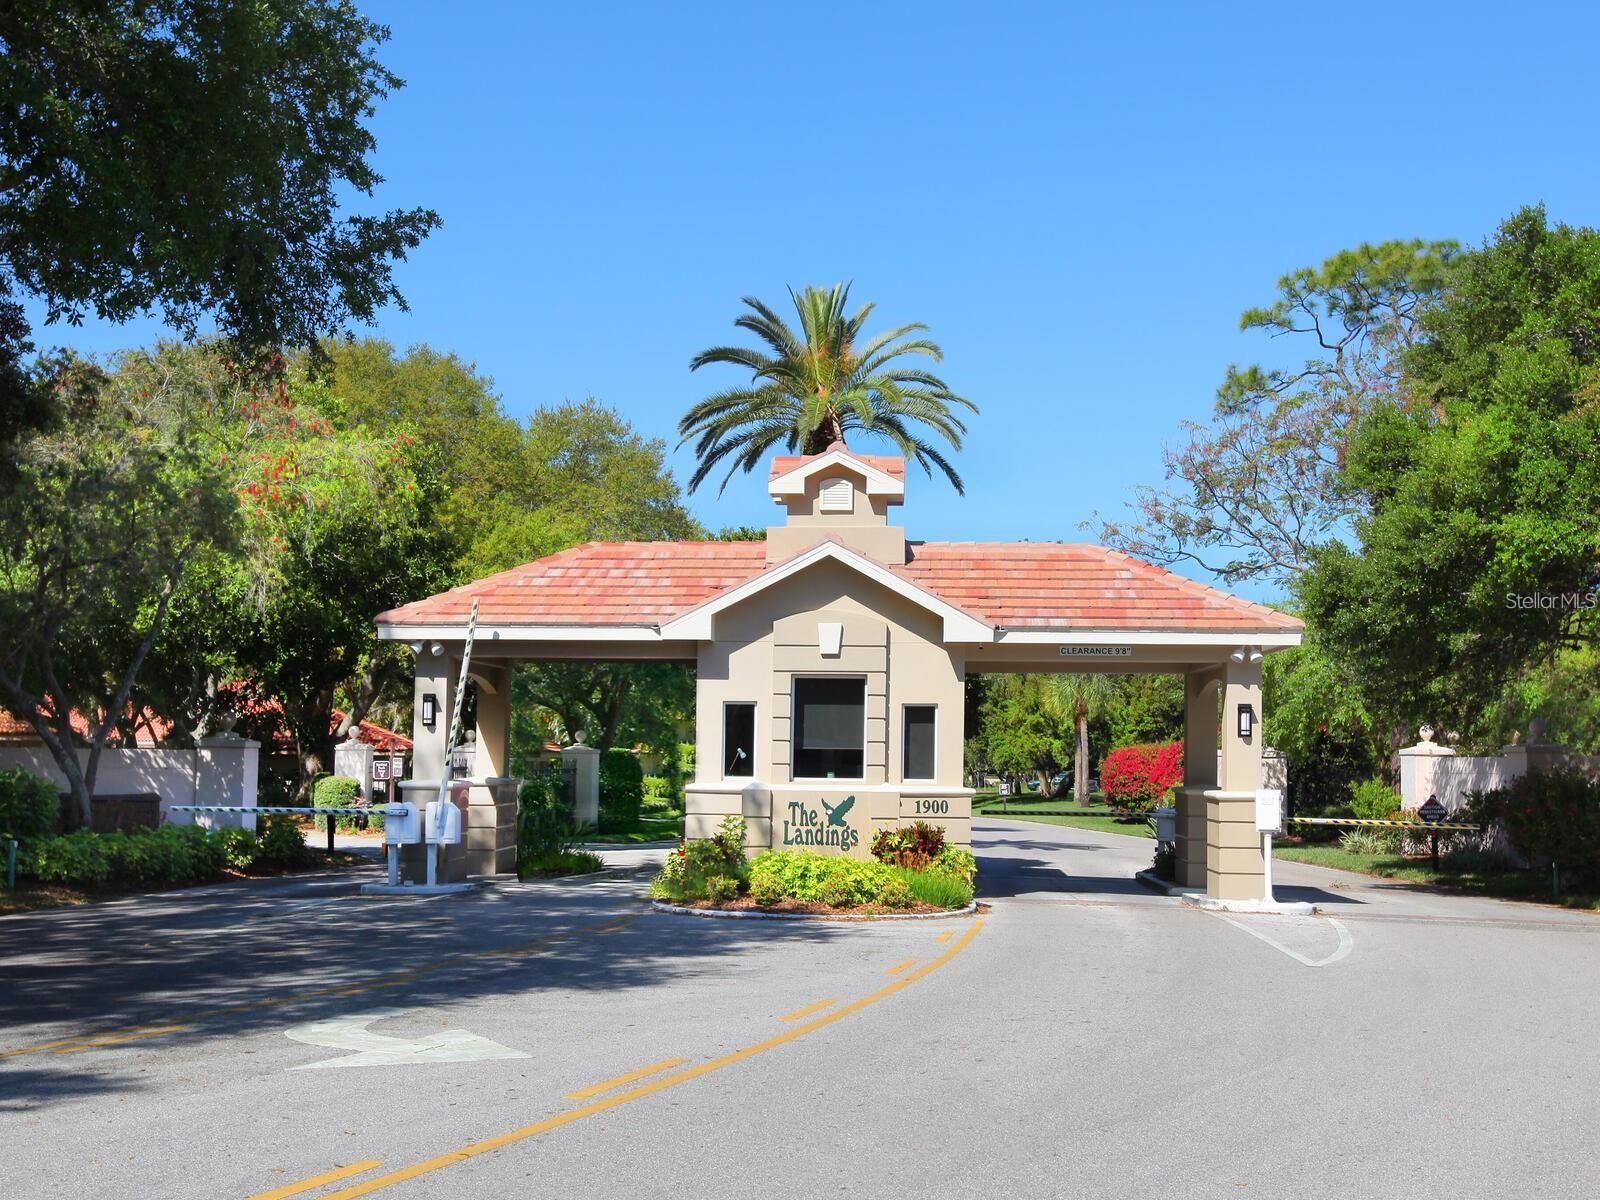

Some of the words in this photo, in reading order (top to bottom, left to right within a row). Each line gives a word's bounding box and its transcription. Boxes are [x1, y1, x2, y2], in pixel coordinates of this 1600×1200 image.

[1060, 647, 1113, 655] CLEARANCE
[788, 801, 818, 827] The
[914, 799, 949, 814] 1900
[783, 820, 859, 852] Landings
